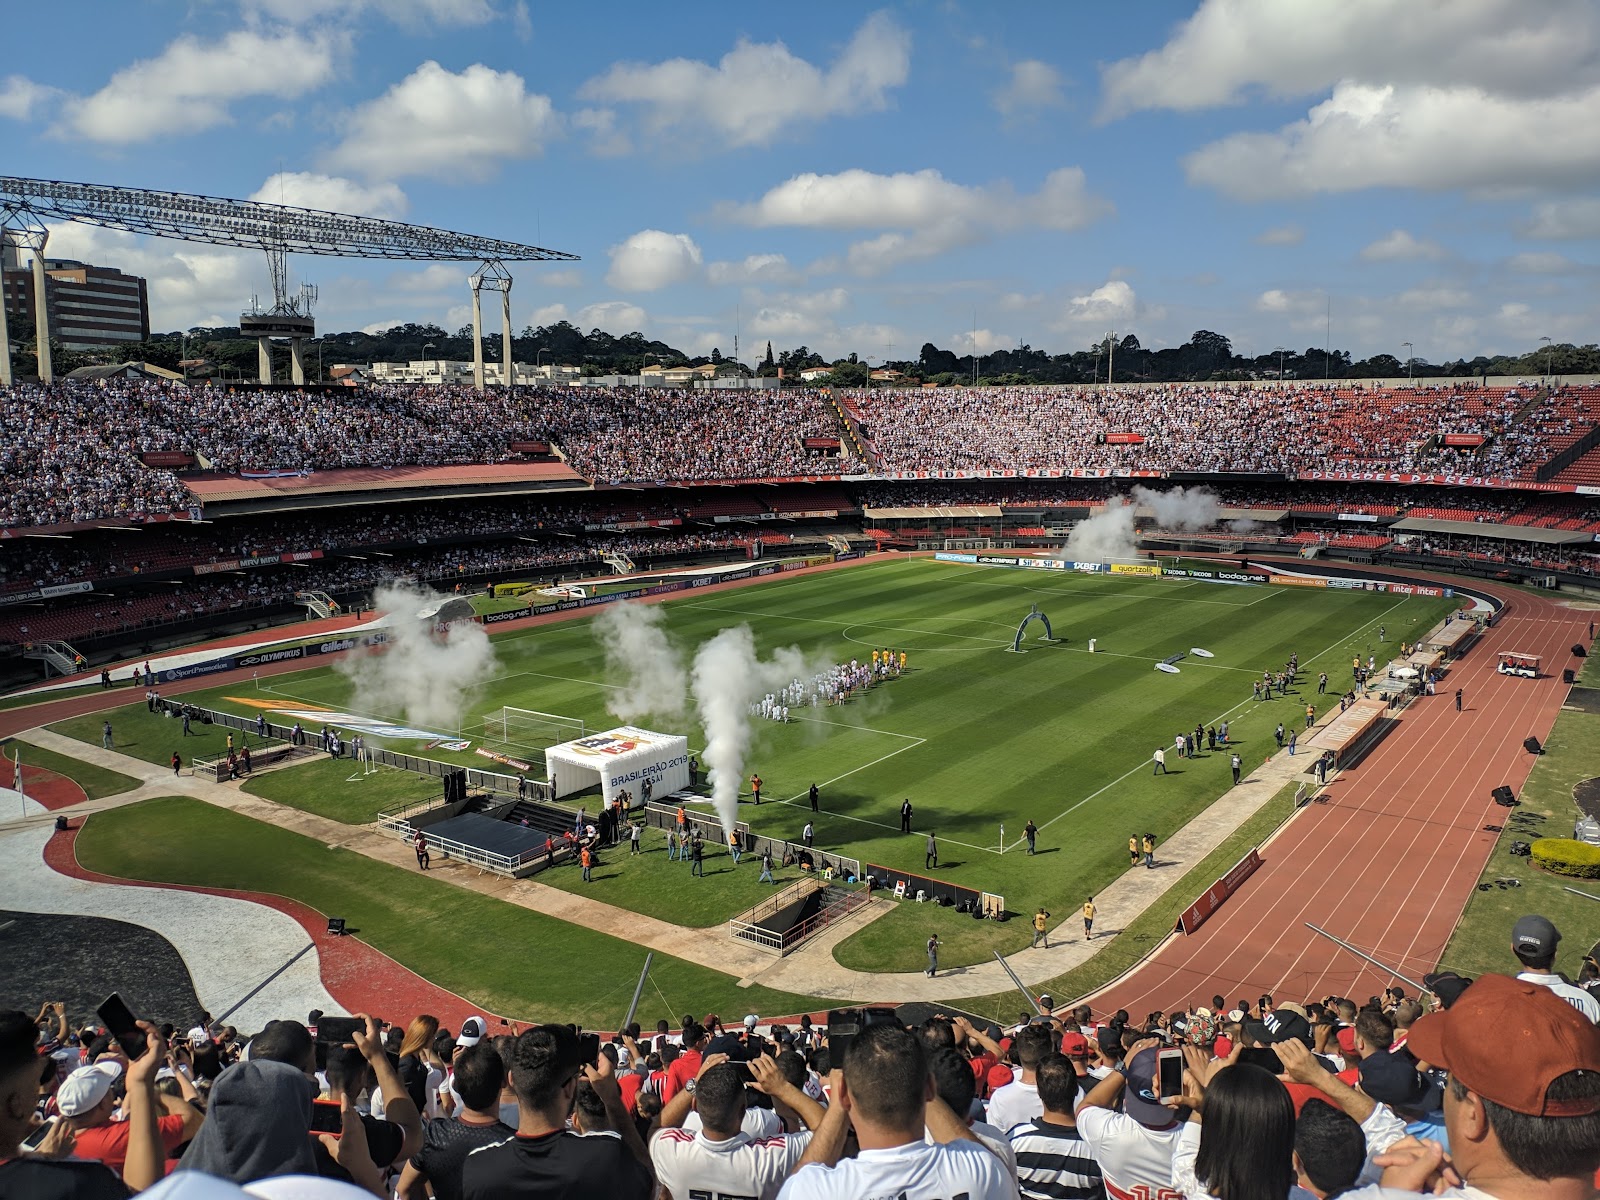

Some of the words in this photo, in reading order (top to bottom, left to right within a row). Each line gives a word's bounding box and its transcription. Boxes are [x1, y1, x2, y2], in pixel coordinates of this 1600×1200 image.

[986, 469, 1119, 477] INDEPENDENTE
[1445, 477, 1494, 486] REAL
[240, 559, 259, 567] MRV
[260, 556, 280, 564] MRV
[1073, 562, 1101, 571] 1XBET
[692, 577, 712, 587] 1XBET
[1219, 572, 1265, 582] bodog.net
[1393, 585, 1413, 594] inter
[1417, 587, 1438, 596] inter
[487, 609, 530, 622] bodog.net
[321, 641, 353, 653] Gillette
[261, 649, 300, 662] OLYMPIKUS
[176, 662, 228, 678] SportPromotion
[611, 761, 668, 788] BRASILEIRÃO
[668, 754, 688, 768] 2019
